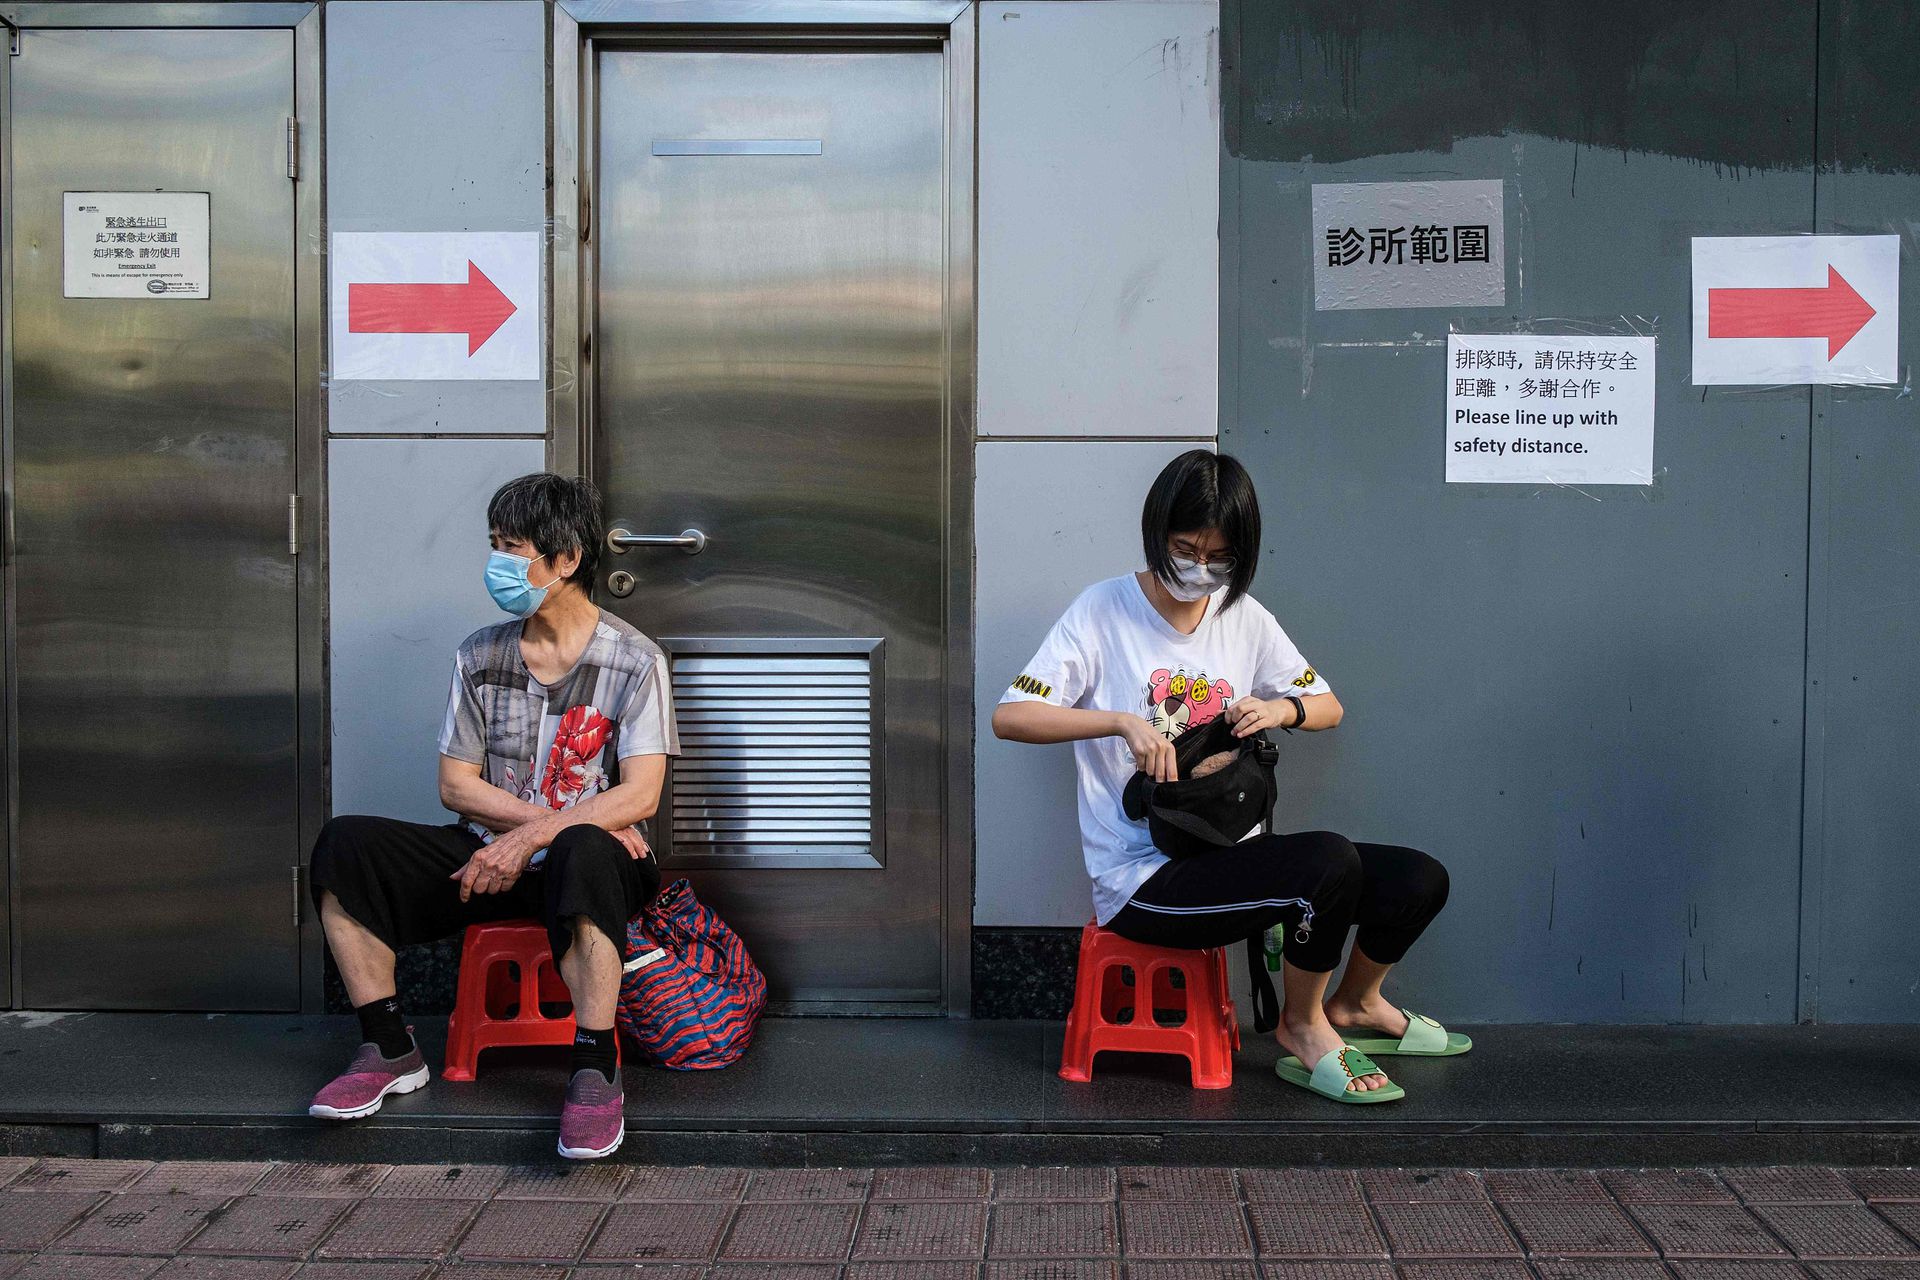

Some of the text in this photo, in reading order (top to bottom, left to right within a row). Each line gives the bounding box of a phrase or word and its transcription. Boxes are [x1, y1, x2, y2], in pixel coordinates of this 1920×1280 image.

[105, 216, 168, 229] 緊急逃生出口
[95, 232, 178, 243] 此乃緊急走火通道
[93, 247, 180, 259] 如非緊急 請勿使用
[1326, 224, 1490, 268] 診所範圍
[1455, 408, 1618, 429] Please line up with
[1454, 437, 1588, 457] safety distance.
